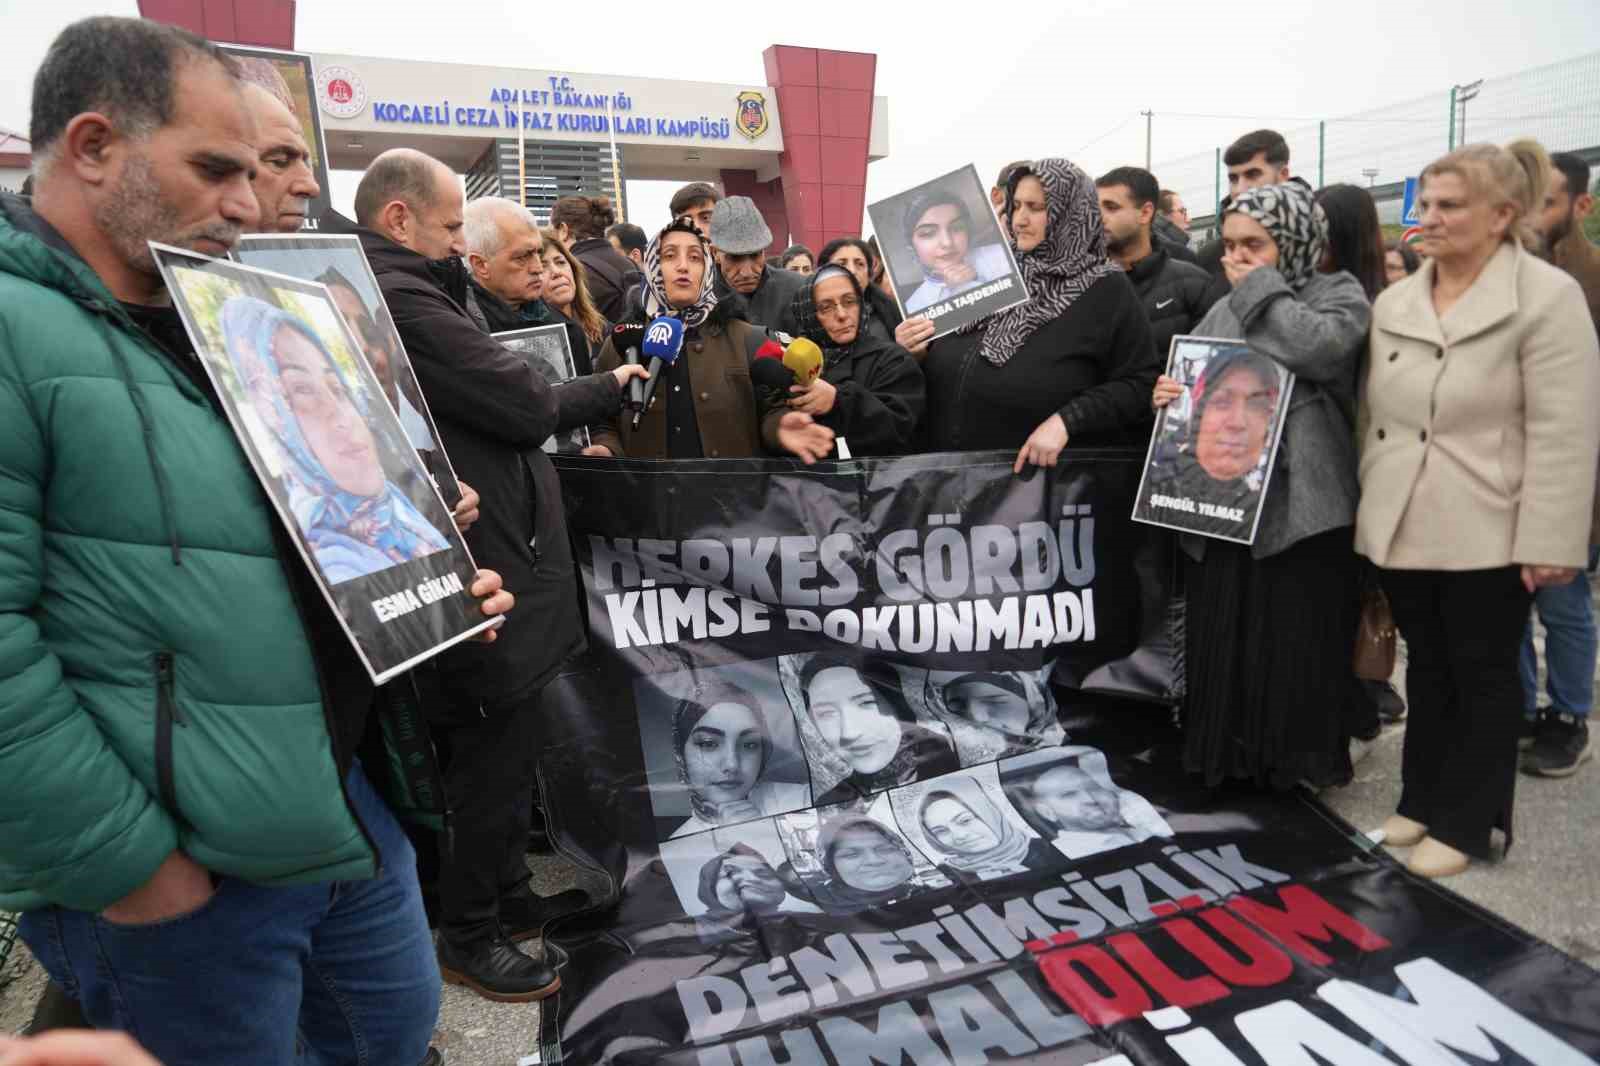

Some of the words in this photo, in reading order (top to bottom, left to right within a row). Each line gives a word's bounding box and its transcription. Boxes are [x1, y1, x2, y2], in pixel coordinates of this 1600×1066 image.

[549, 76, 575, 91] T.C.
[373, 101, 450, 124] KOCAELİ
[455, 107, 500, 127] CEZA
[657, 116, 729, 139] KAMPÜSÜ
[913, 303, 954, 320] UĞBA
[953, 278, 1013, 306] TAŞDEMİR
[1150, 494, 1195, 513] ŞENGÜL
[1198, 502, 1244, 522] YILMAZ
[876, 504, 1095, 601] GÖRDÜ
[371, 588, 423, 623] ESMA
[417, 571, 464, 605] GİKAN
[605, 578, 771, 649] KİMSE
[676, 843, 1291, 1043] DENETİMSİZLİK
[1023, 884, 1392, 1027] ÖLÜM
